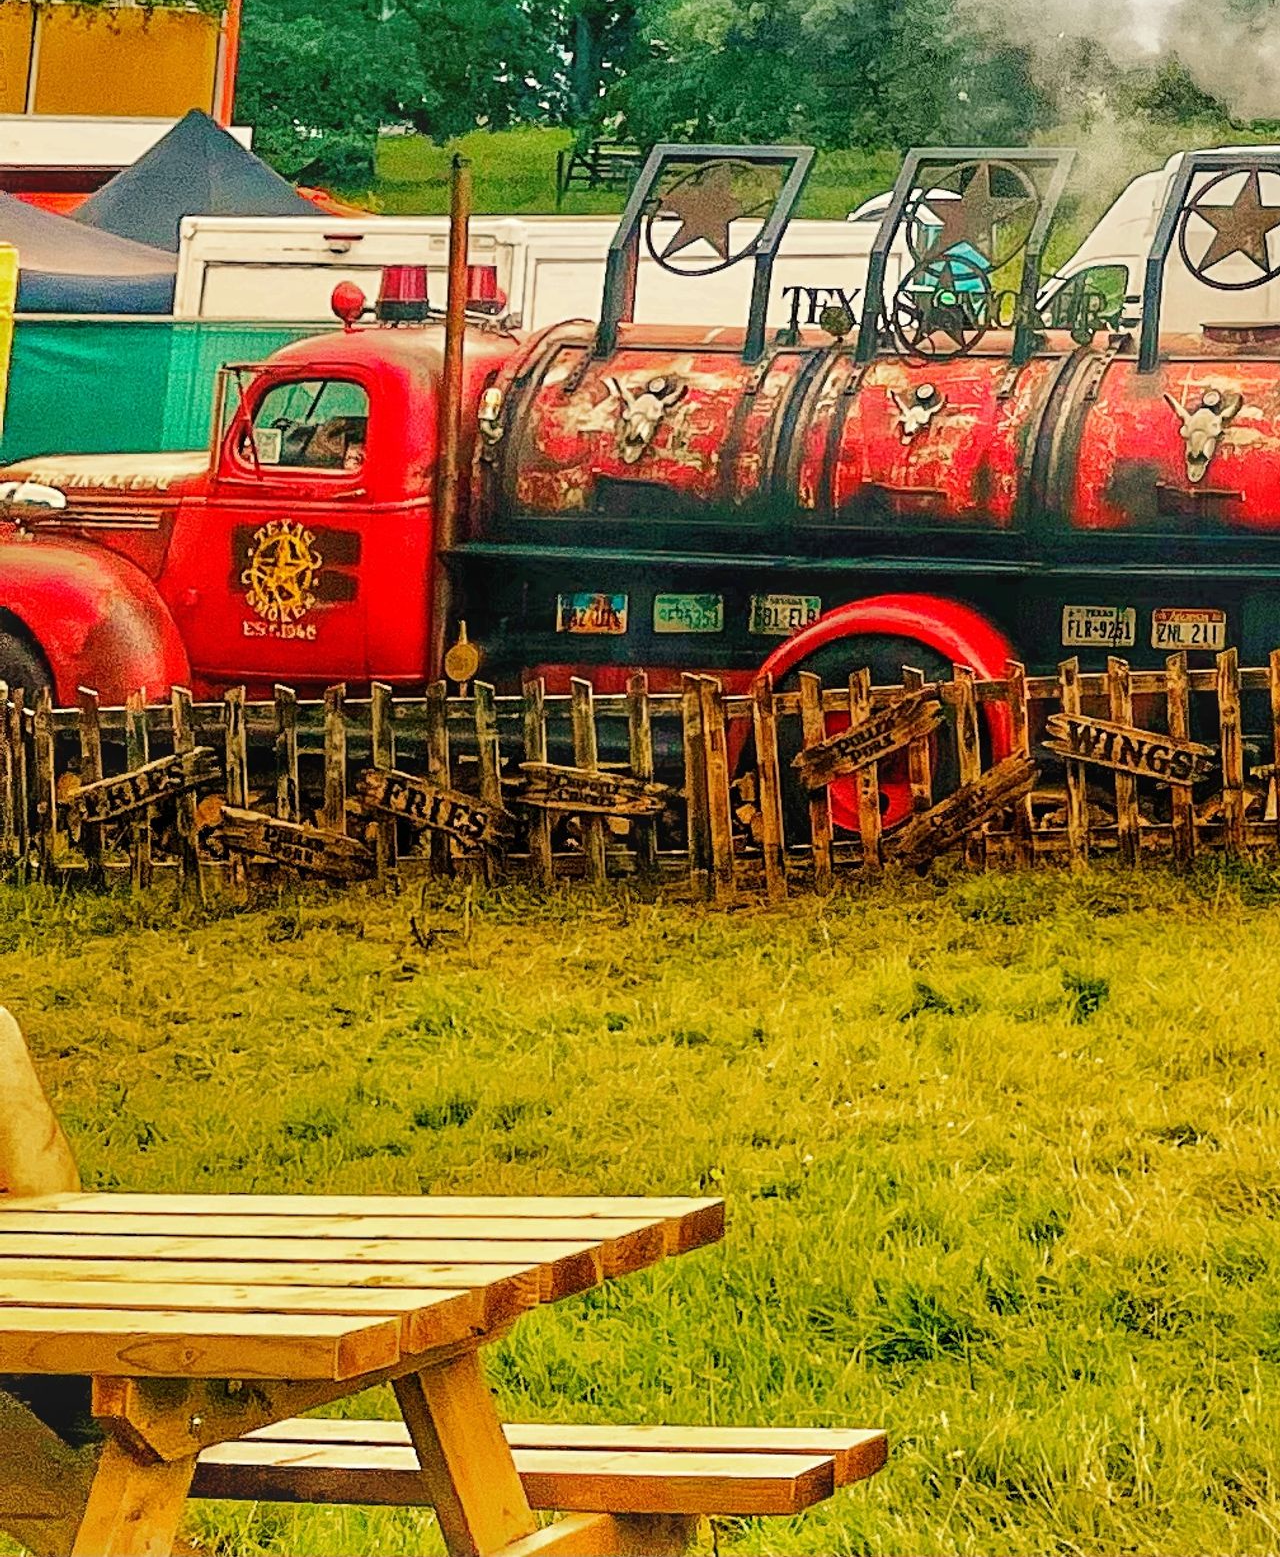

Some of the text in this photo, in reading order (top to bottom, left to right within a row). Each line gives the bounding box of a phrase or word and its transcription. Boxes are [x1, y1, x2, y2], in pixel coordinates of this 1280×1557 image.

[253, 518, 317, 546] TEXAS
[1067, 720, 1193, 780] WINGS
[384, 779, 487, 837] FRIES
